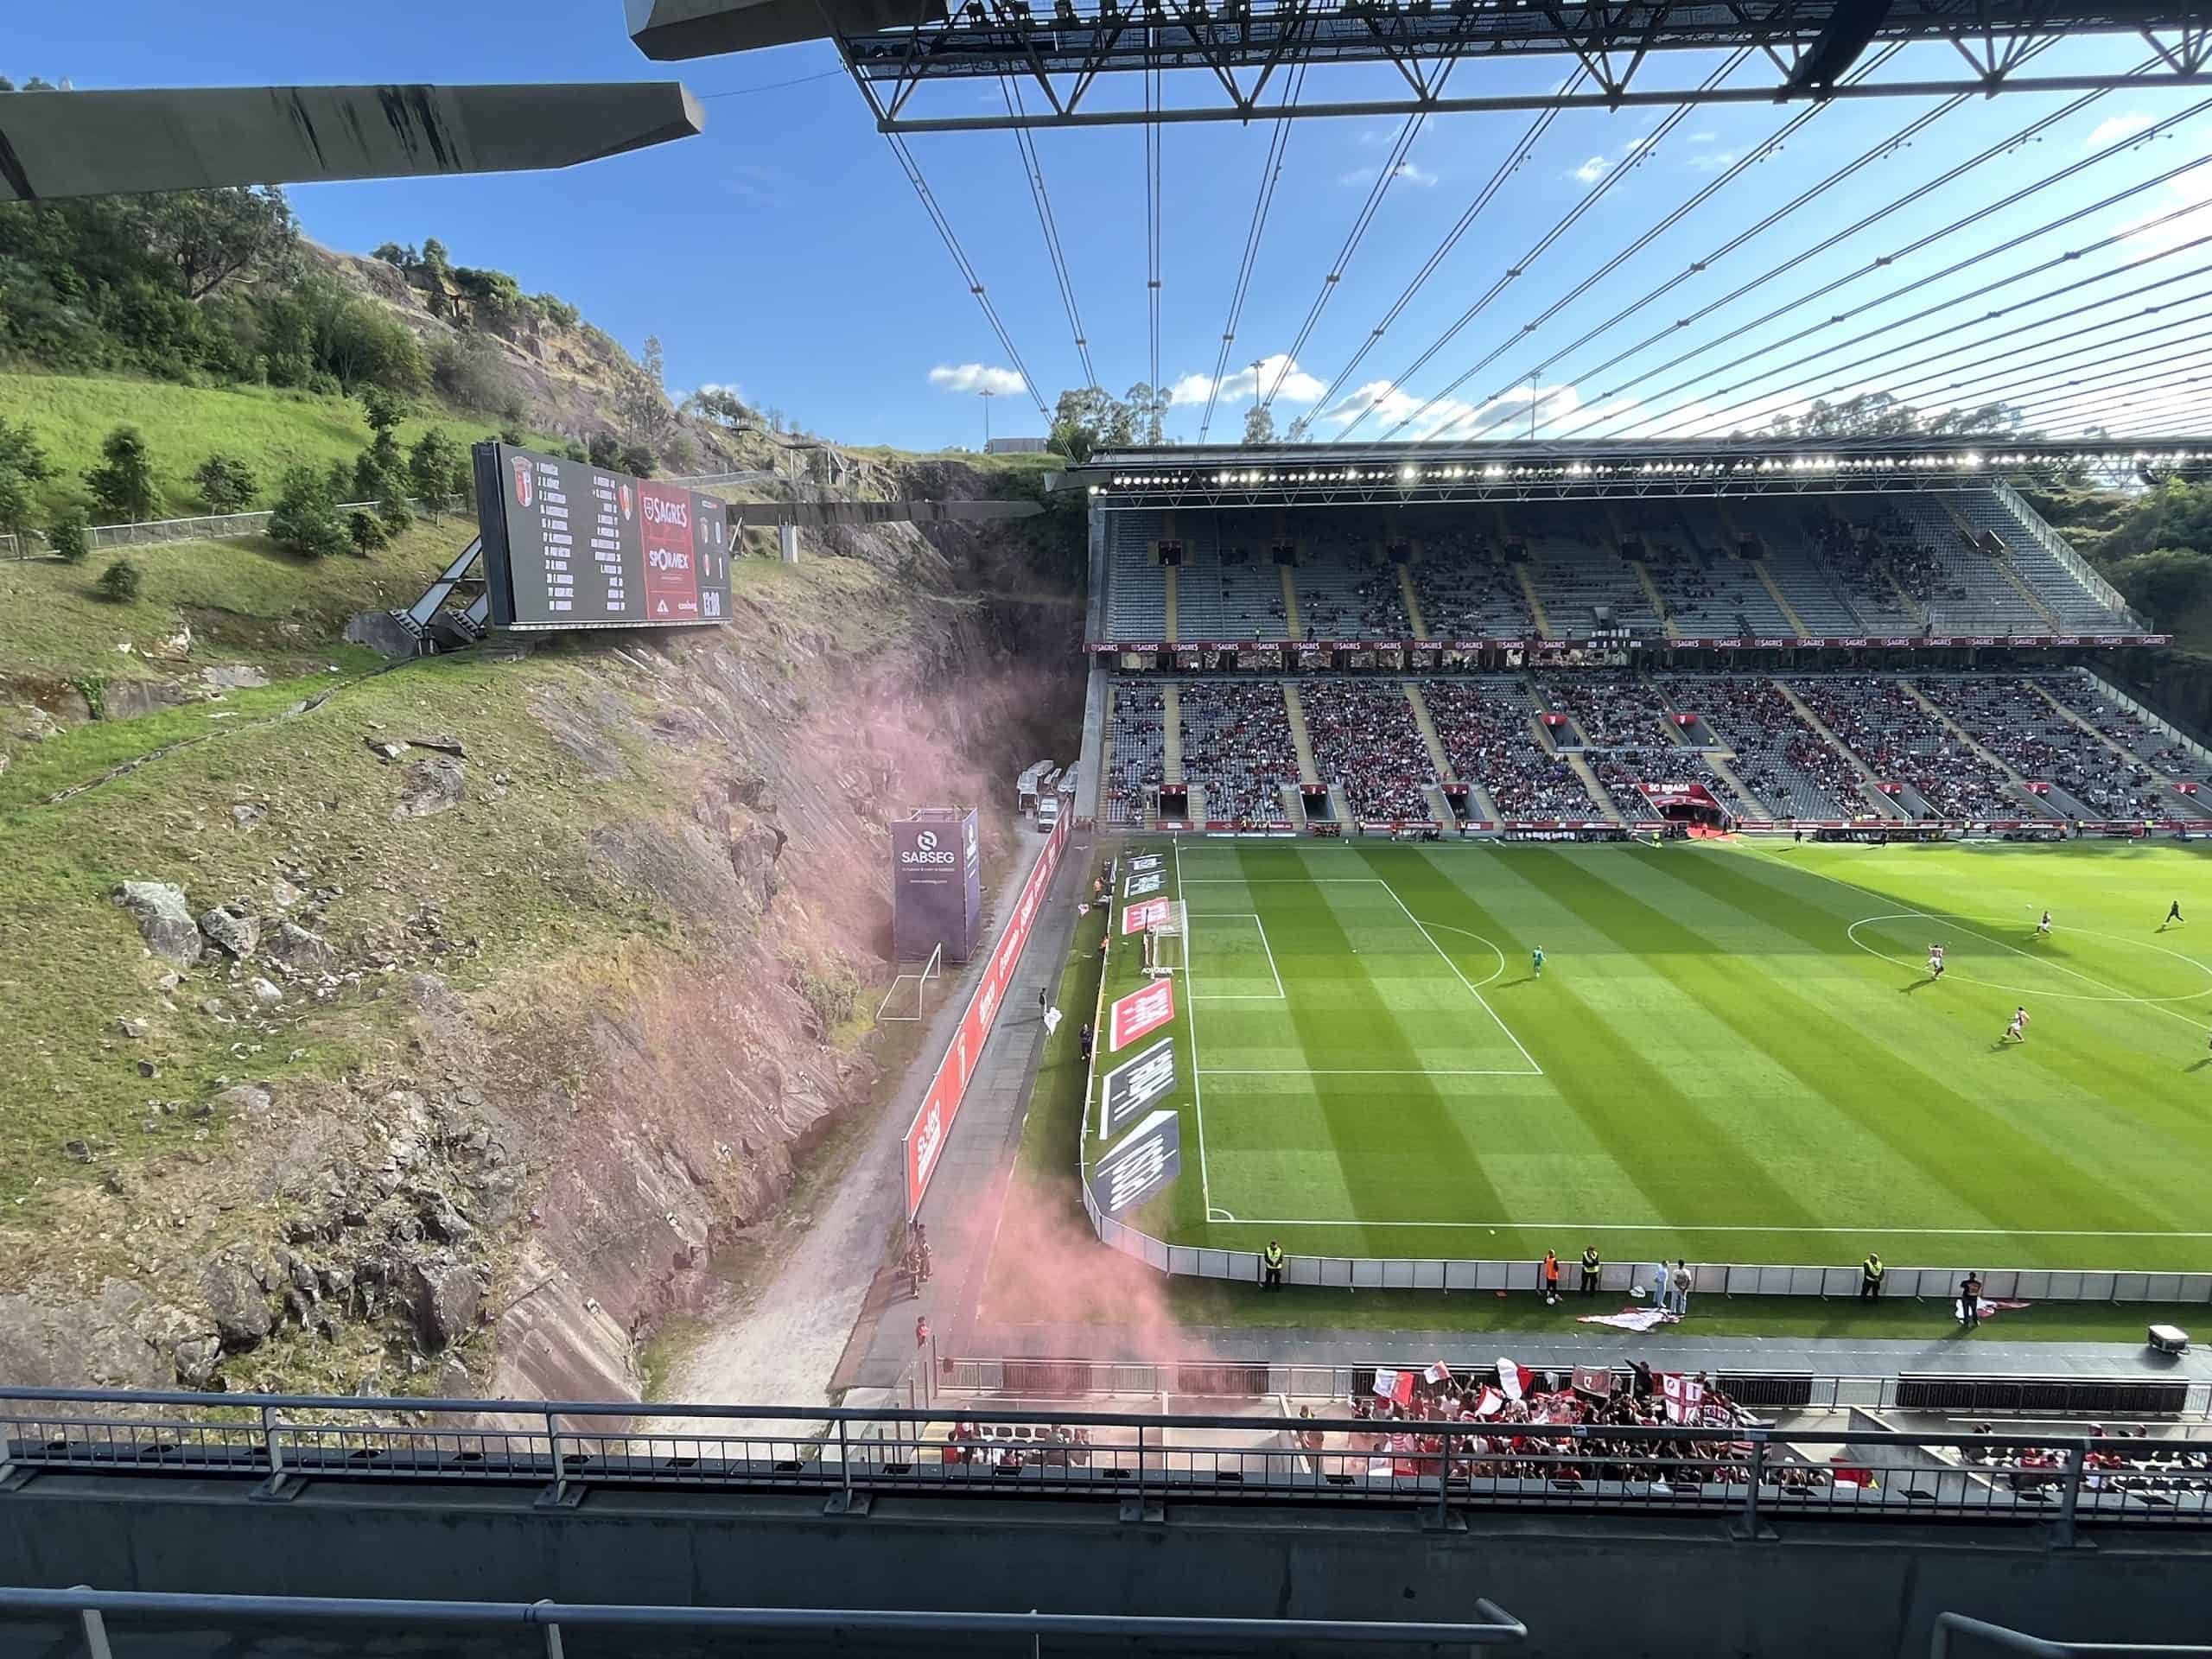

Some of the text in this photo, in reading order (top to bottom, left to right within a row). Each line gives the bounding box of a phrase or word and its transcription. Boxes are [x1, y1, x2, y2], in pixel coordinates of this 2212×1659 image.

[653, 498, 688, 528] SAGRES
[715, 521, 721, 544] 0
[718, 556, 723, 580] 1
[1097, 641, 1566, 652] SAGRES SAGRES SAGRES SAGRES SAGRES SAGRES SAGRES SAGRES SAGRES SAGRES SAGRES SAGRES
[1649, 784, 1690, 792] SC BRAGA
[901, 851, 955, 863] SABSEG
